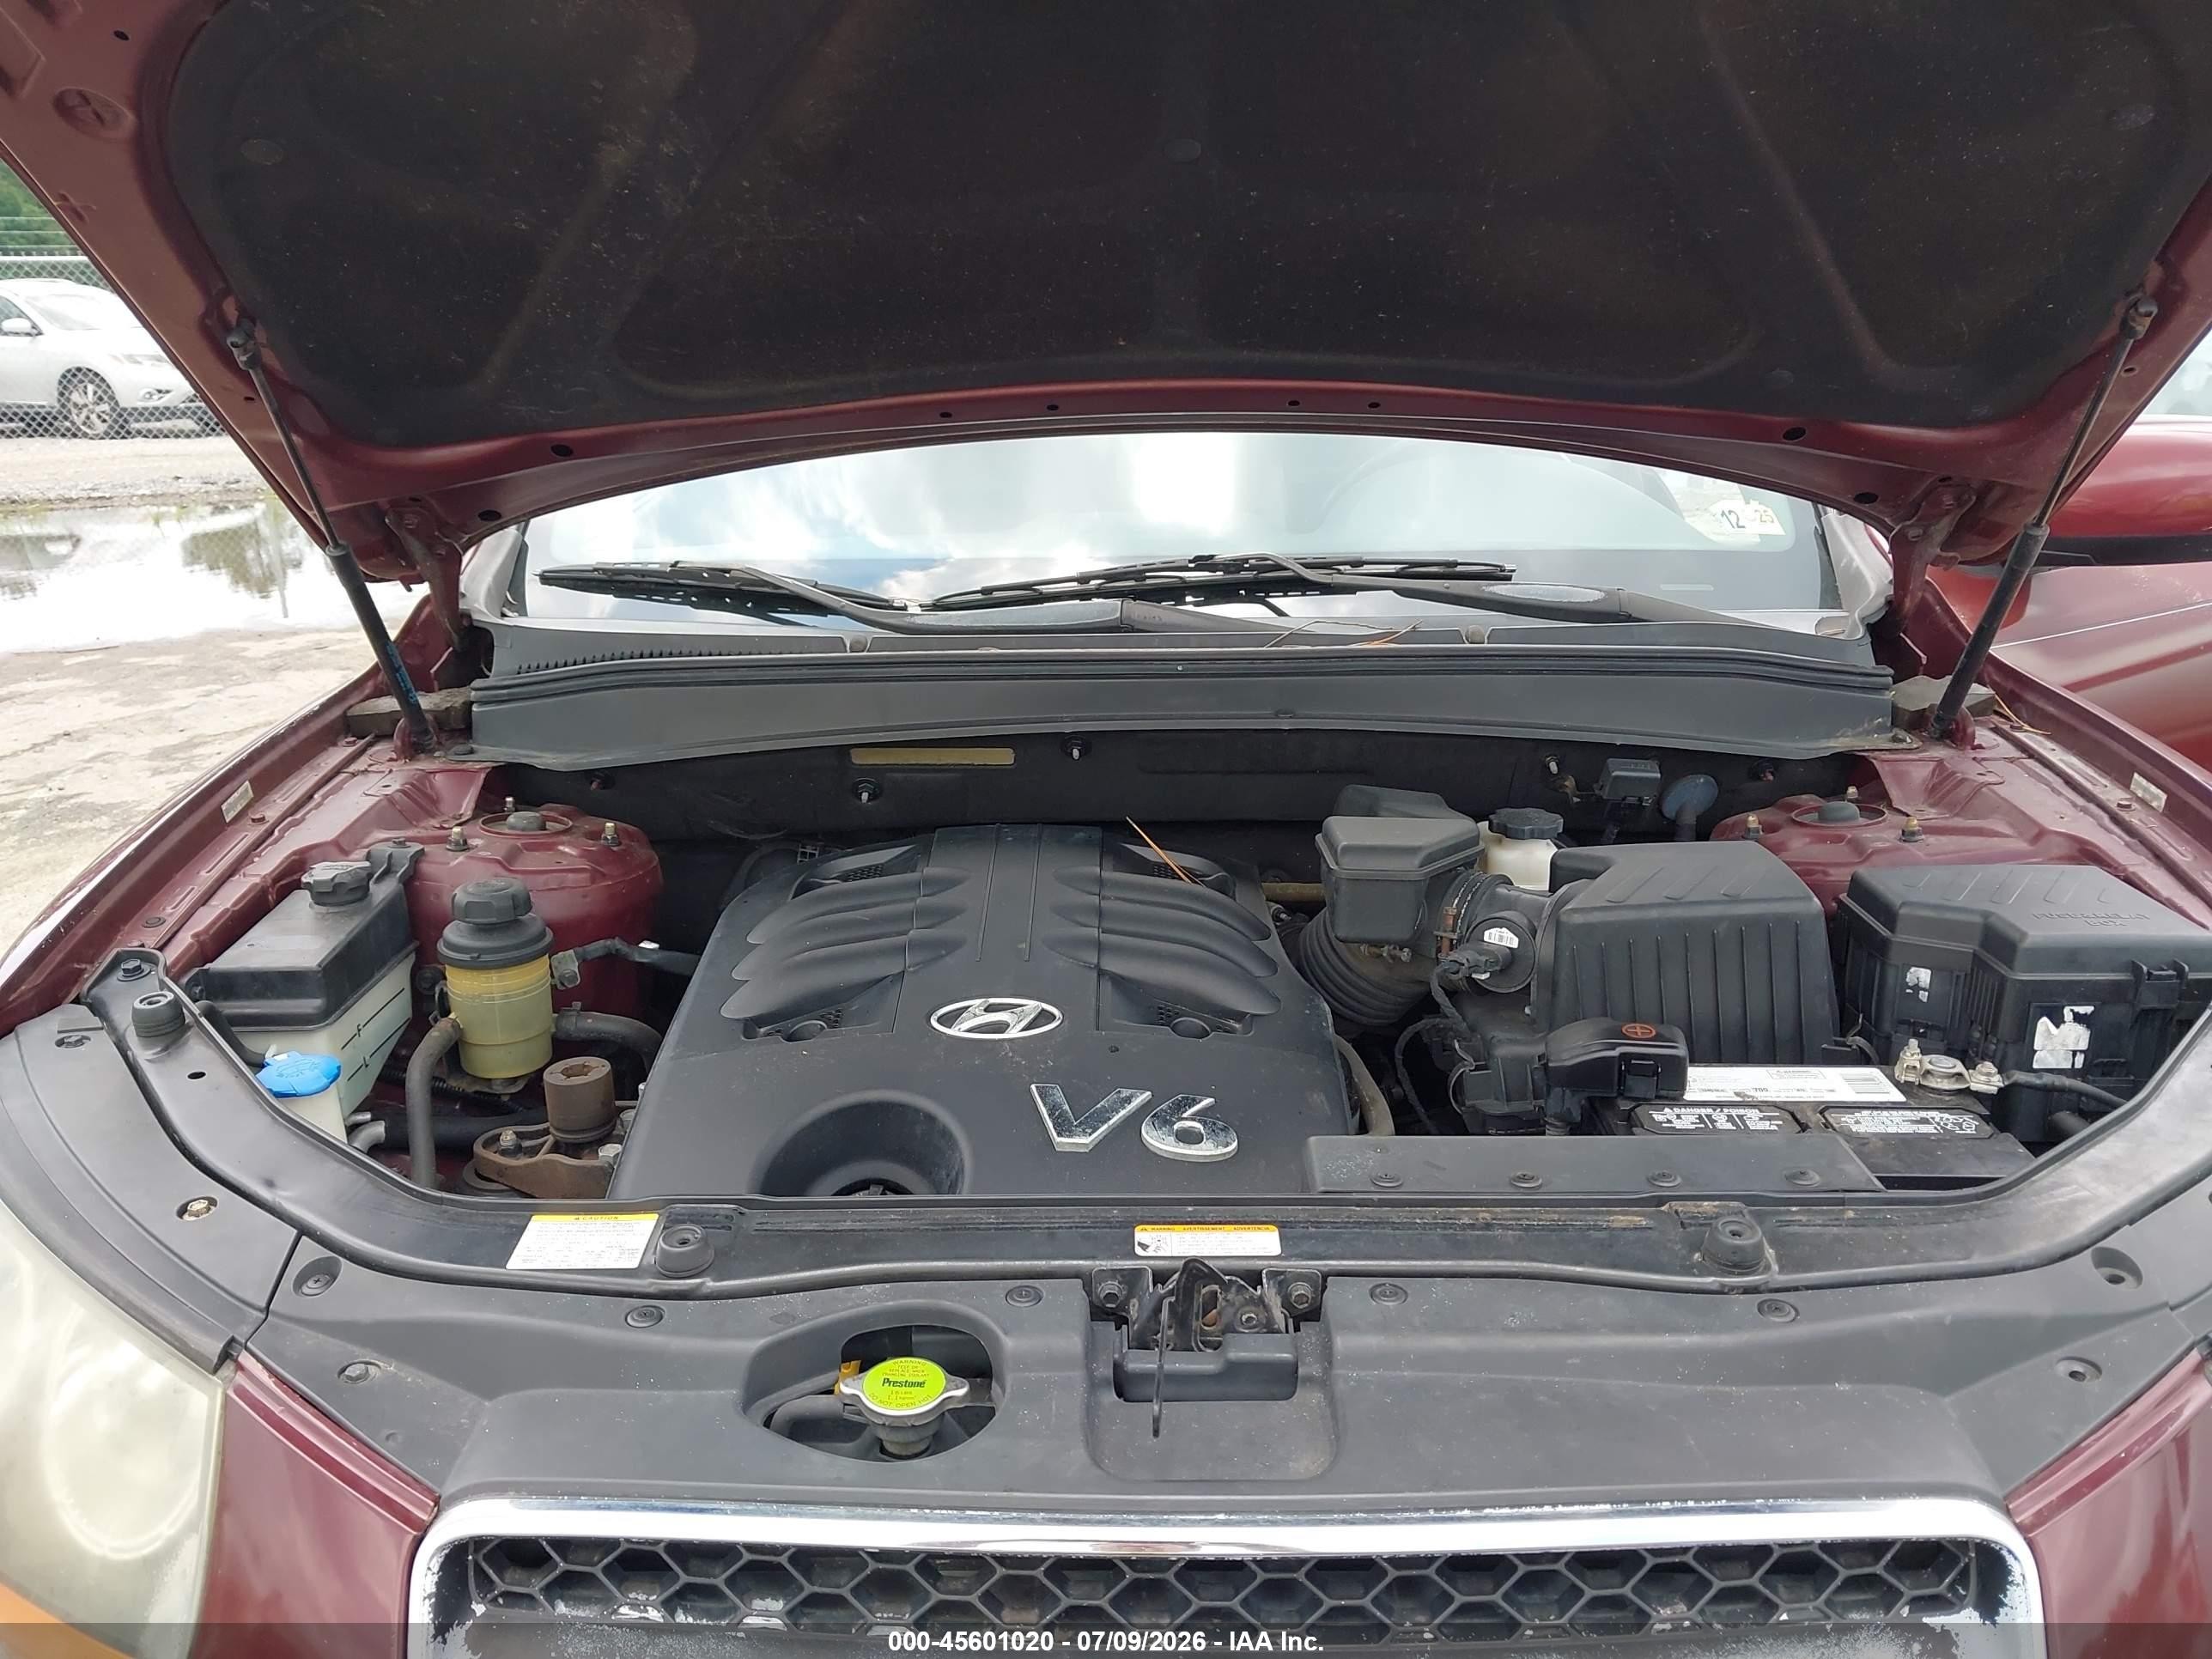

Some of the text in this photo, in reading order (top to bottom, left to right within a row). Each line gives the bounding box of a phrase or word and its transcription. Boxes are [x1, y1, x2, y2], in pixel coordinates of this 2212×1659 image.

[1720, 508, 1747, 529] 12
[1030, 1084, 1239, 1163] V6
[882, 1377, 926, 1388] Prestone
